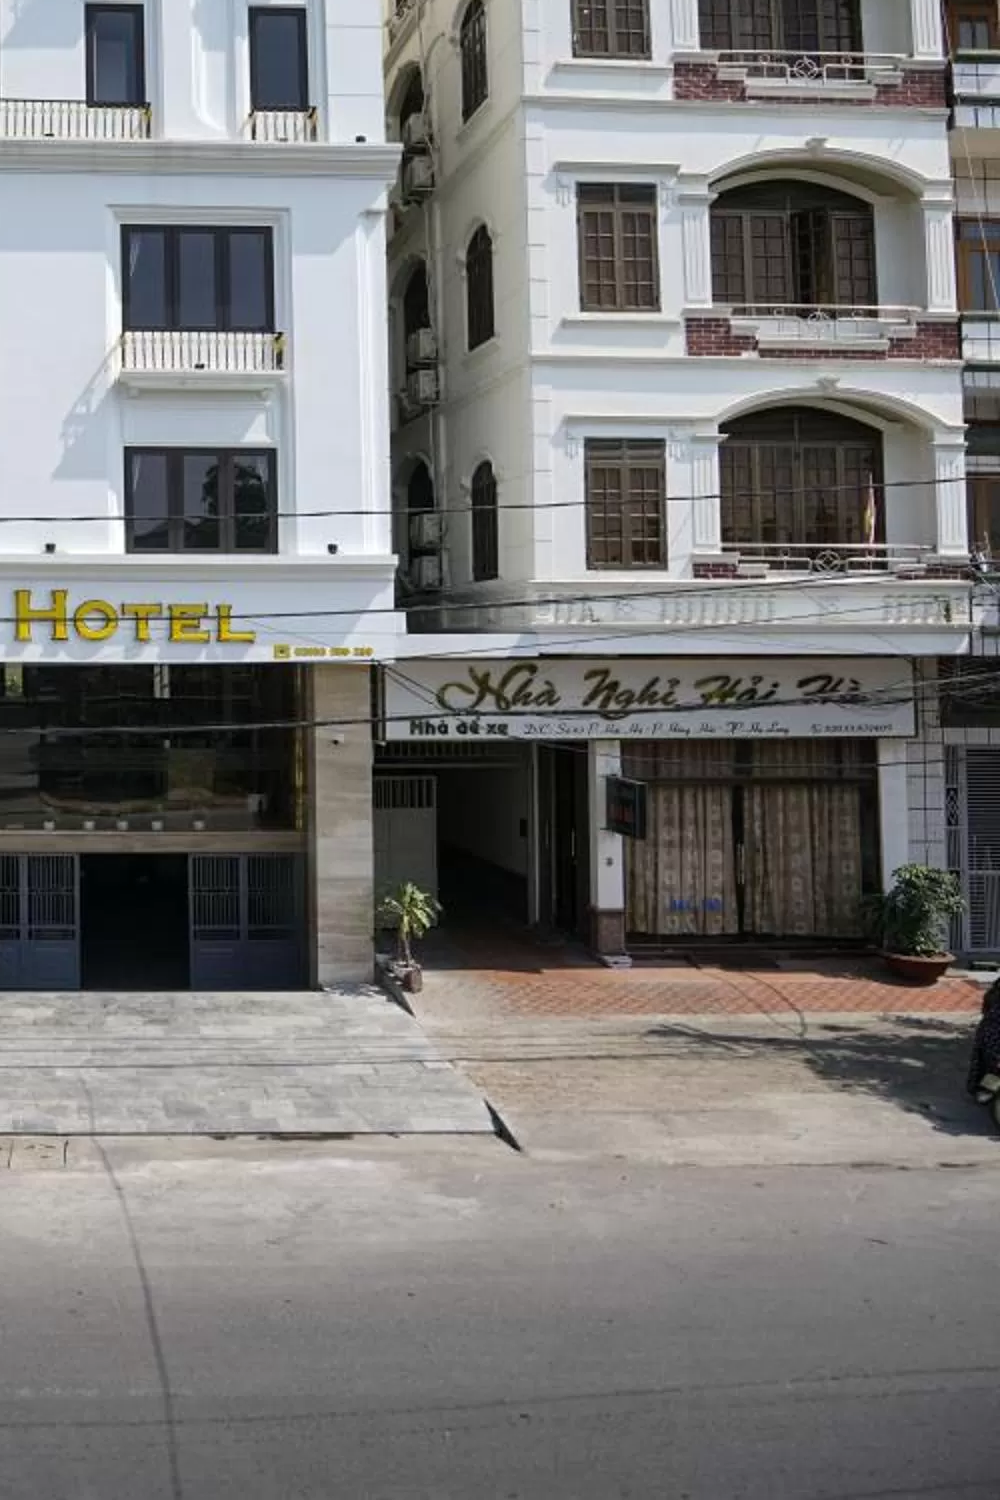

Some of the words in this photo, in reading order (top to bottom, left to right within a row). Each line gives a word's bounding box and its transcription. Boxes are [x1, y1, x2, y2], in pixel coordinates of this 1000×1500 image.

[13, 588, 257, 644] HOTEL
[437, 663, 561, 711] Nhà
[582, 668, 680, 715] Nghỉ
